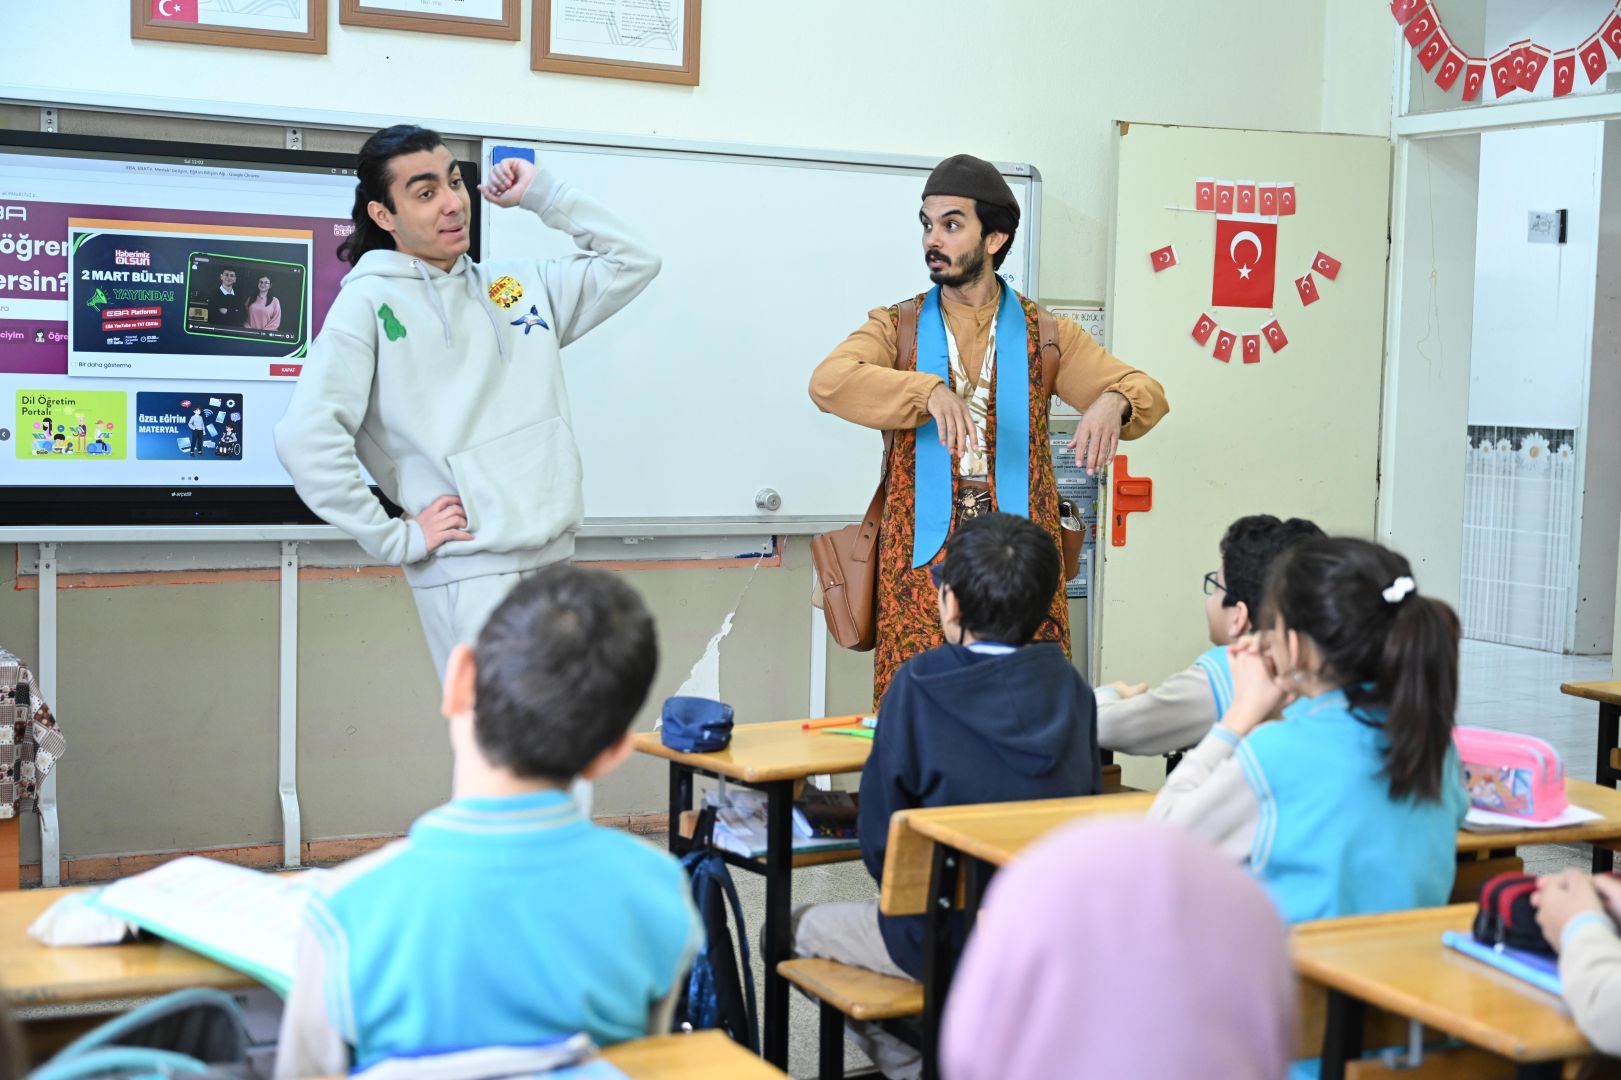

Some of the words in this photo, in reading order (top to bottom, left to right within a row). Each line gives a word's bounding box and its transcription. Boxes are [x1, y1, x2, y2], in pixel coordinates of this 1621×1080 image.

[0, 206, 27, 221] A
[115, 250, 150, 258] Haberimiz
[81, 270, 90, 281] 2
[92, 270, 130, 282] MART
[132, 270, 184, 284] BÜLTENİ
[113, 289, 174, 302] YAYINDA!
[22, 396, 35, 405] Dil
[38, 394, 76, 408] Öğretim
[22, 407, 51, 416] Portalı
[139, 413, 159, 423] ÖZEL
[160, 413, 186, 424] EĞİTİM
[139, 426, 179, 434] MATERYAL
